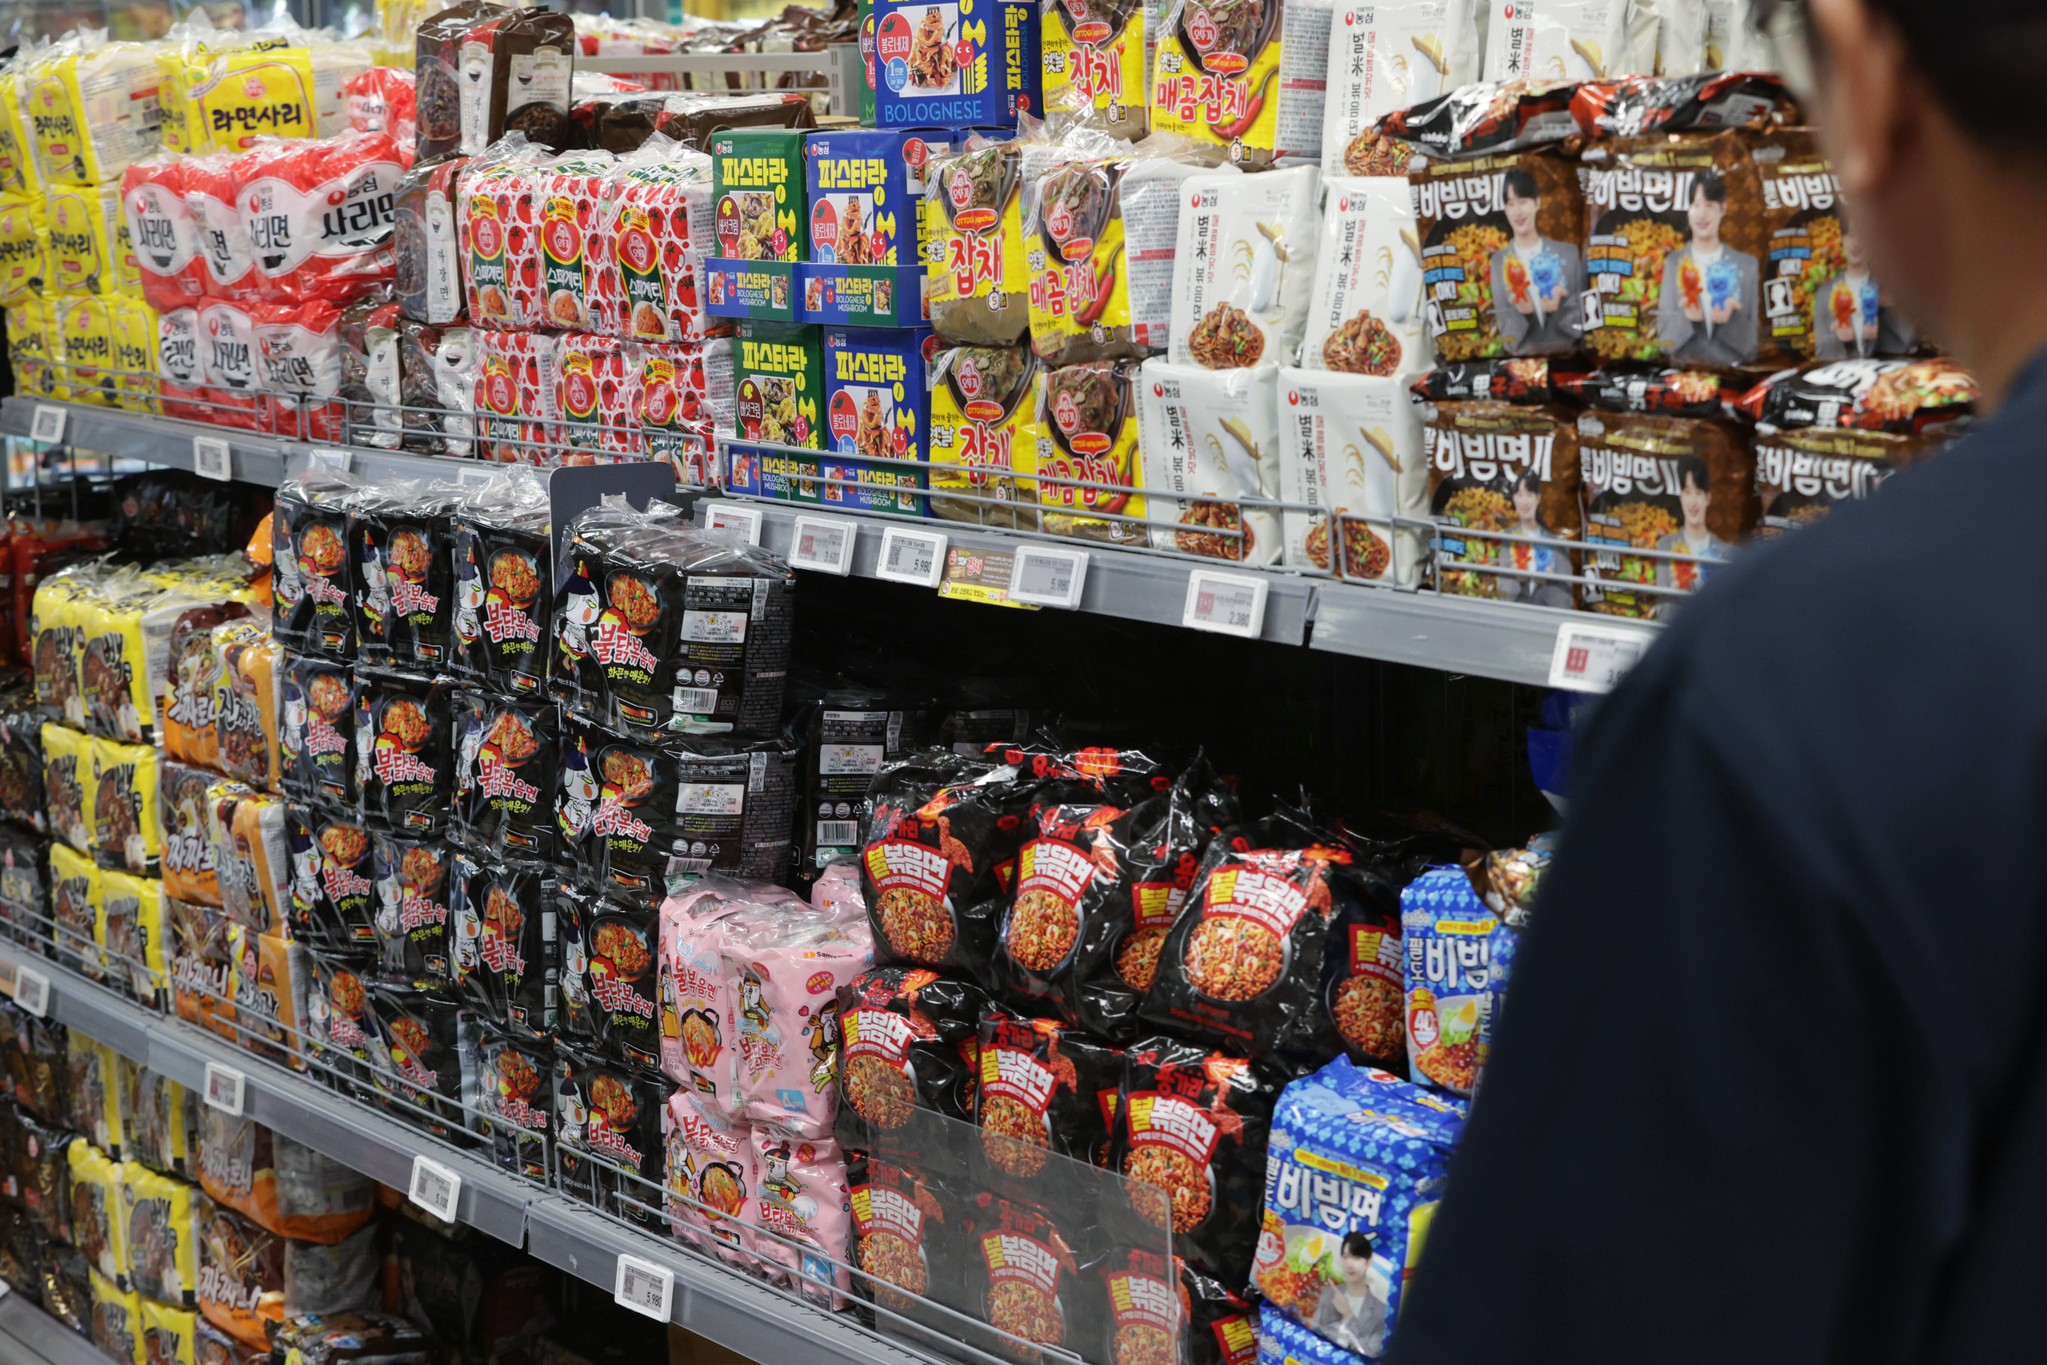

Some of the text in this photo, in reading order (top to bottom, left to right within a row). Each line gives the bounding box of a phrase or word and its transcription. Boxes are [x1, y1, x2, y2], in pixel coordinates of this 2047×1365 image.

[881, 35, 910, 55] 볼로네제
[1074, 30, 1093, 39] OTTOGI
[1193, 27, 1213, 43] 오뚜기
[889, 61, 905, 77] 1인분
[1021, 22, 1030, 90] BOLOGNESE
[1044, 50, 1066, 73] 옛날
[1159, 50, 1184, 73] 옛날
[1069, 43, 1122, 103] 잡채
[884, 99, 983, 123] BOLOGNESE
[1156, 73, 1250, 124] 매콤잡채
[212, 104, 302, 133] 라면사리
[722, 157, 789, 205] 파스타랑
[818, 158, 888, 207] 파스타랑
[952, 185, 970, 201] 오뚜기
[718, 218, 739, 236] 버섯크림
[813, 222, 836, 240] 볼로네제
[474, 266, 505, 285] 스파게티
[546, 267, 583, 286] 스파게티
[950, 230, 1003, 298] 잡채
[628, 276, 664, 301] 스파게티
[737, 289, 764, 299] BOLOGNESE
[1029, 260, 1099, 317] 매콤잡채
[1435, 280, 1458, 302] OK!
[1598, 272, 1621, 294] OK!
[739, 298, 767, 308] MUSHROOM
[835, 295, 866, 306] BOLOGNESE
[838, 303, 868, 313] MUSHROOM
[264, 356, 316, 388] 사리면
[741, 341, 807, 392] 파스타랑
[835, 351, 906, 402] 파스타랑
[739, 400, 761, 419] 버섯크림
[832, 413, 857, 431] 볼로네제
[857, 486, 889, 498] BOLOGNESE
[859, 496, 891, 507] MUSHROOM
[484, 600, 542, 644] 불닭볶음면
[591, 620, 659, 674] 불닭볶음면
[721, 698, 736, 706] ECO
[305, 720, 347, 757] 불닭볶음면
[375, 745, 436, 785] 불닭볶음면
[478, 755, 540, 803] 불닭볶음면
[867, 843, 949, 889] 불볶음면
[1021, 842, 1095, 894] 불볶음면
[1209, 869, 1308, 935] 불볶음면
[590, 969, 654, 1019] 불닭볶음면
[843, 1010, 912, 1055] 불볶음면
[981, 1049, 1055, 1105] 불볶음면
[1155, 1061, 1206, 1098] 용가리
[1129, 1096, 1217, 1157] 불볶음면
[851, 1188, 922, 1239] 불볶음면
[984, 1233, 1059, 1288] 불볶음면
